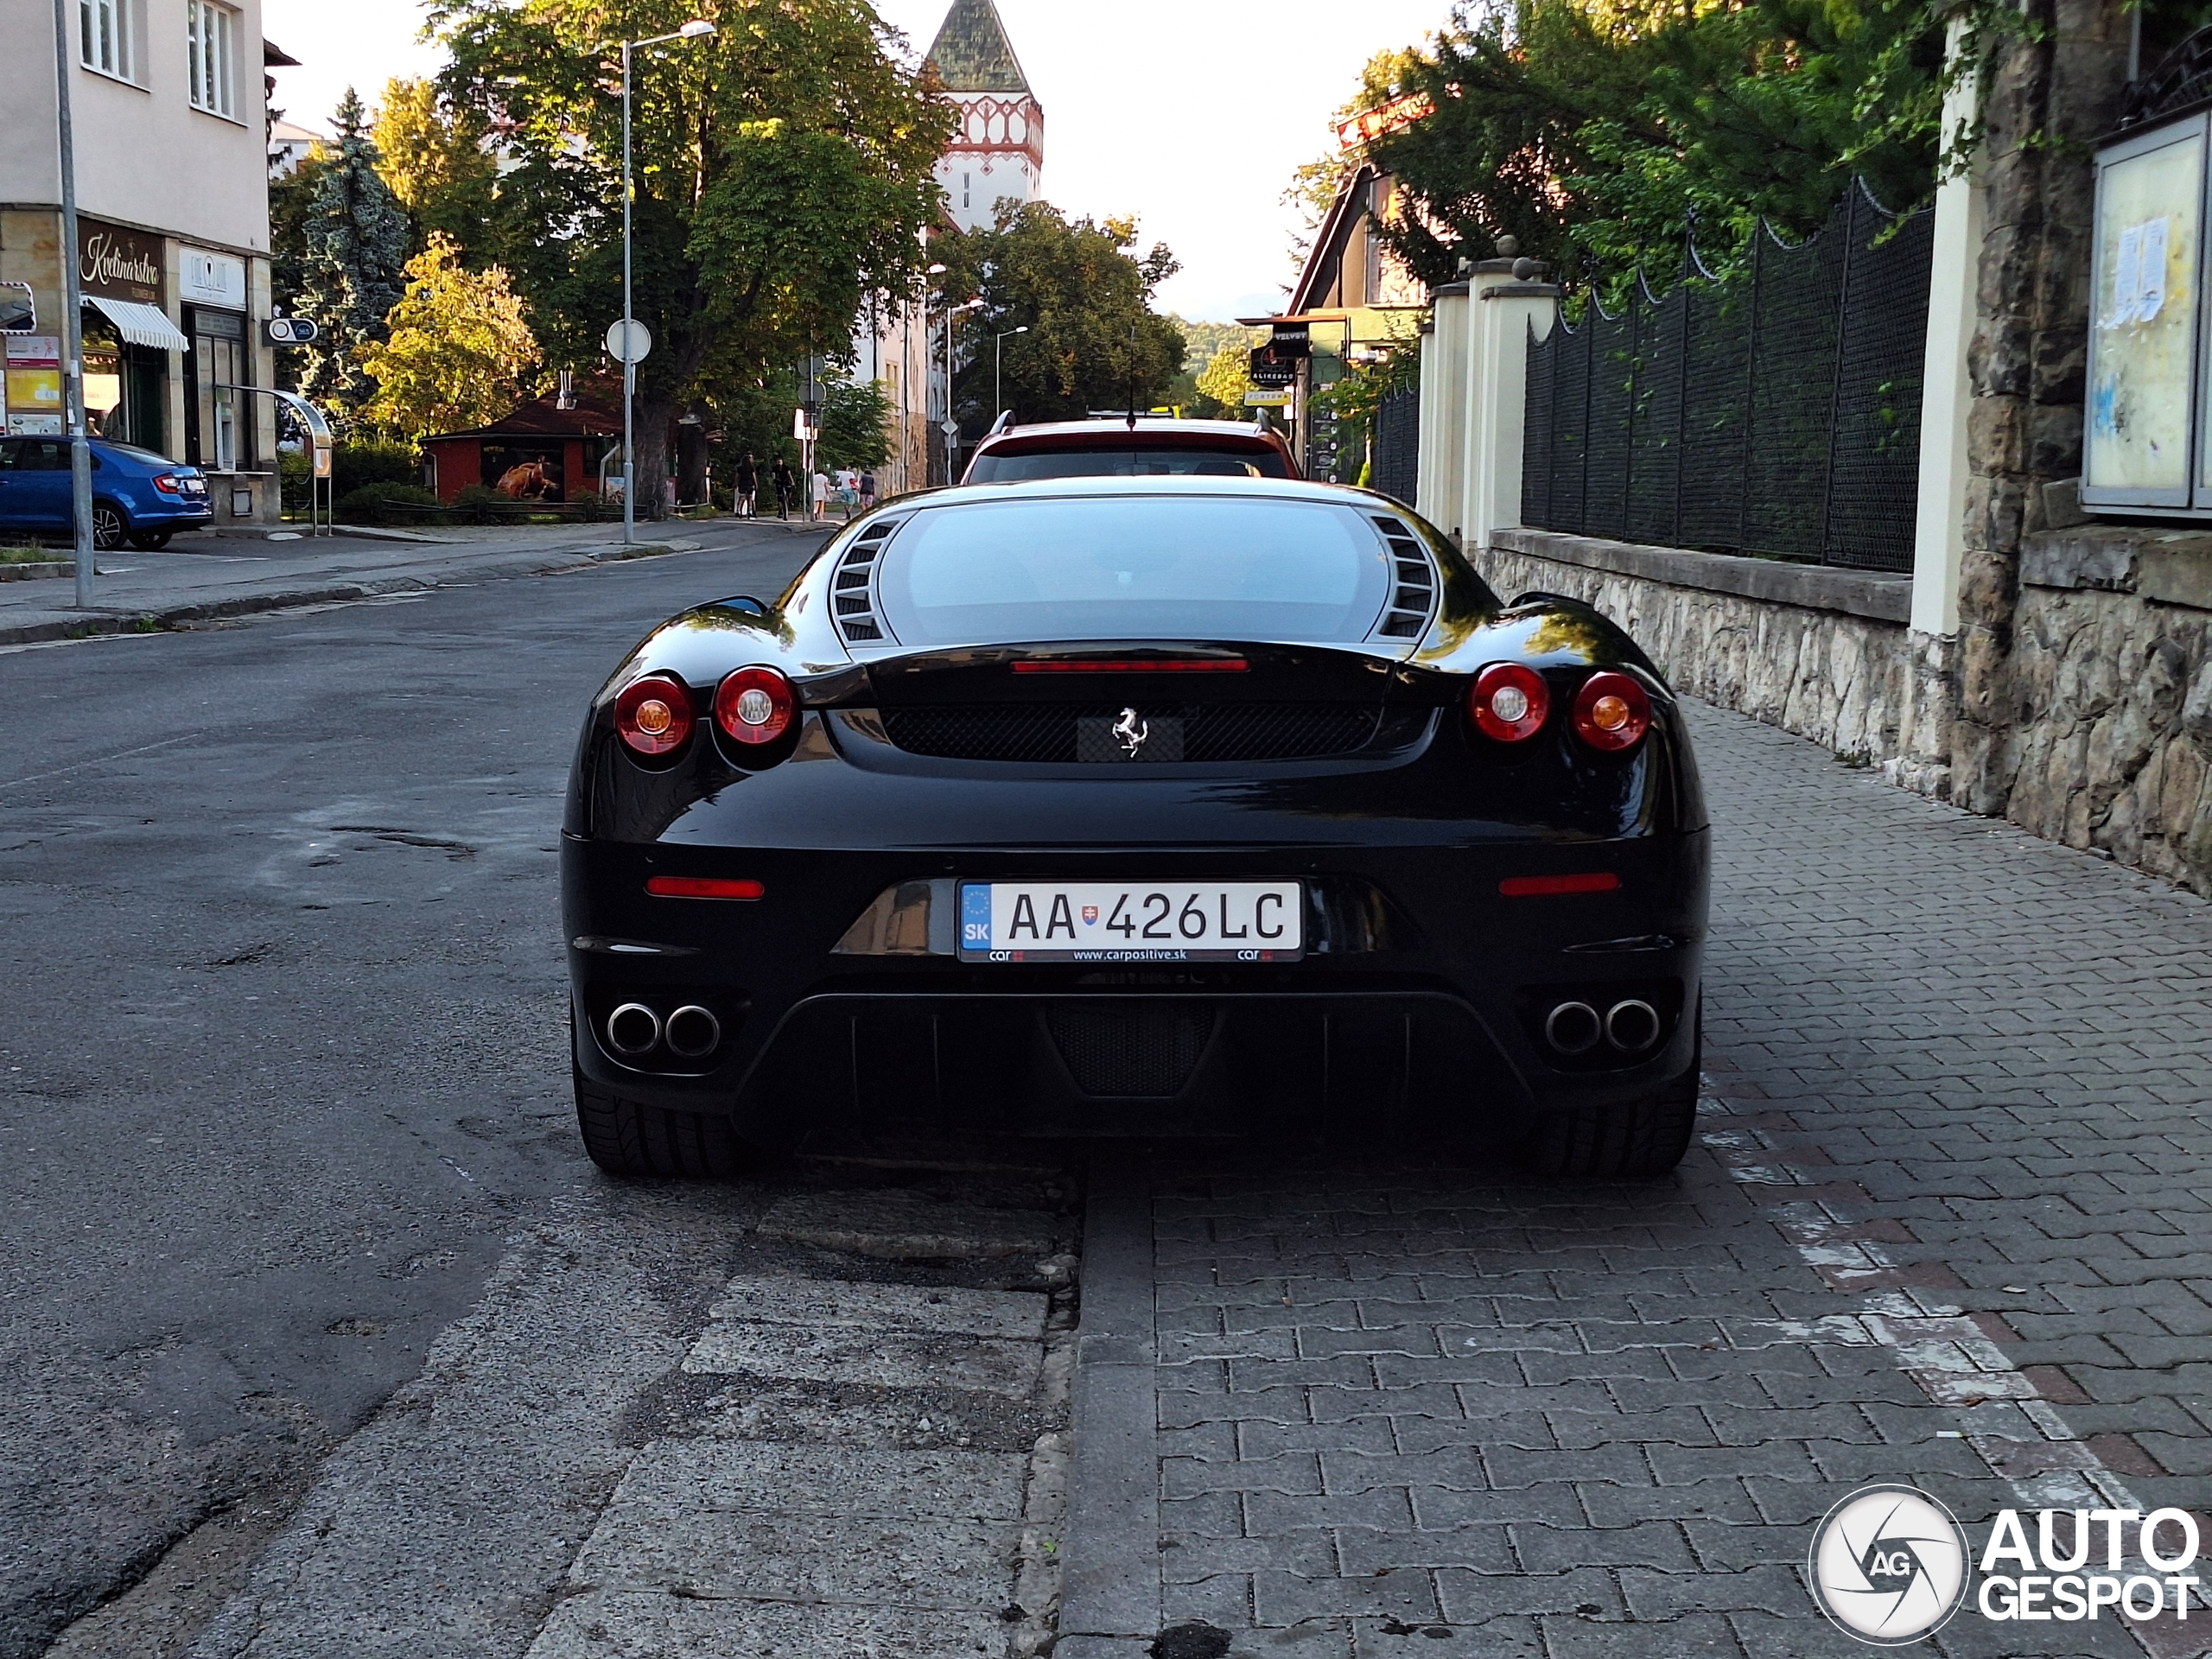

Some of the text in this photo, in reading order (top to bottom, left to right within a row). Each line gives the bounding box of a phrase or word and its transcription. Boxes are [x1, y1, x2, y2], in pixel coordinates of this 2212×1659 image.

[1009, 893, 1077, 939] AA
[964, 924, 989, 940] SK
[1073, 949, 1187, 963] www.carpositive.sk
